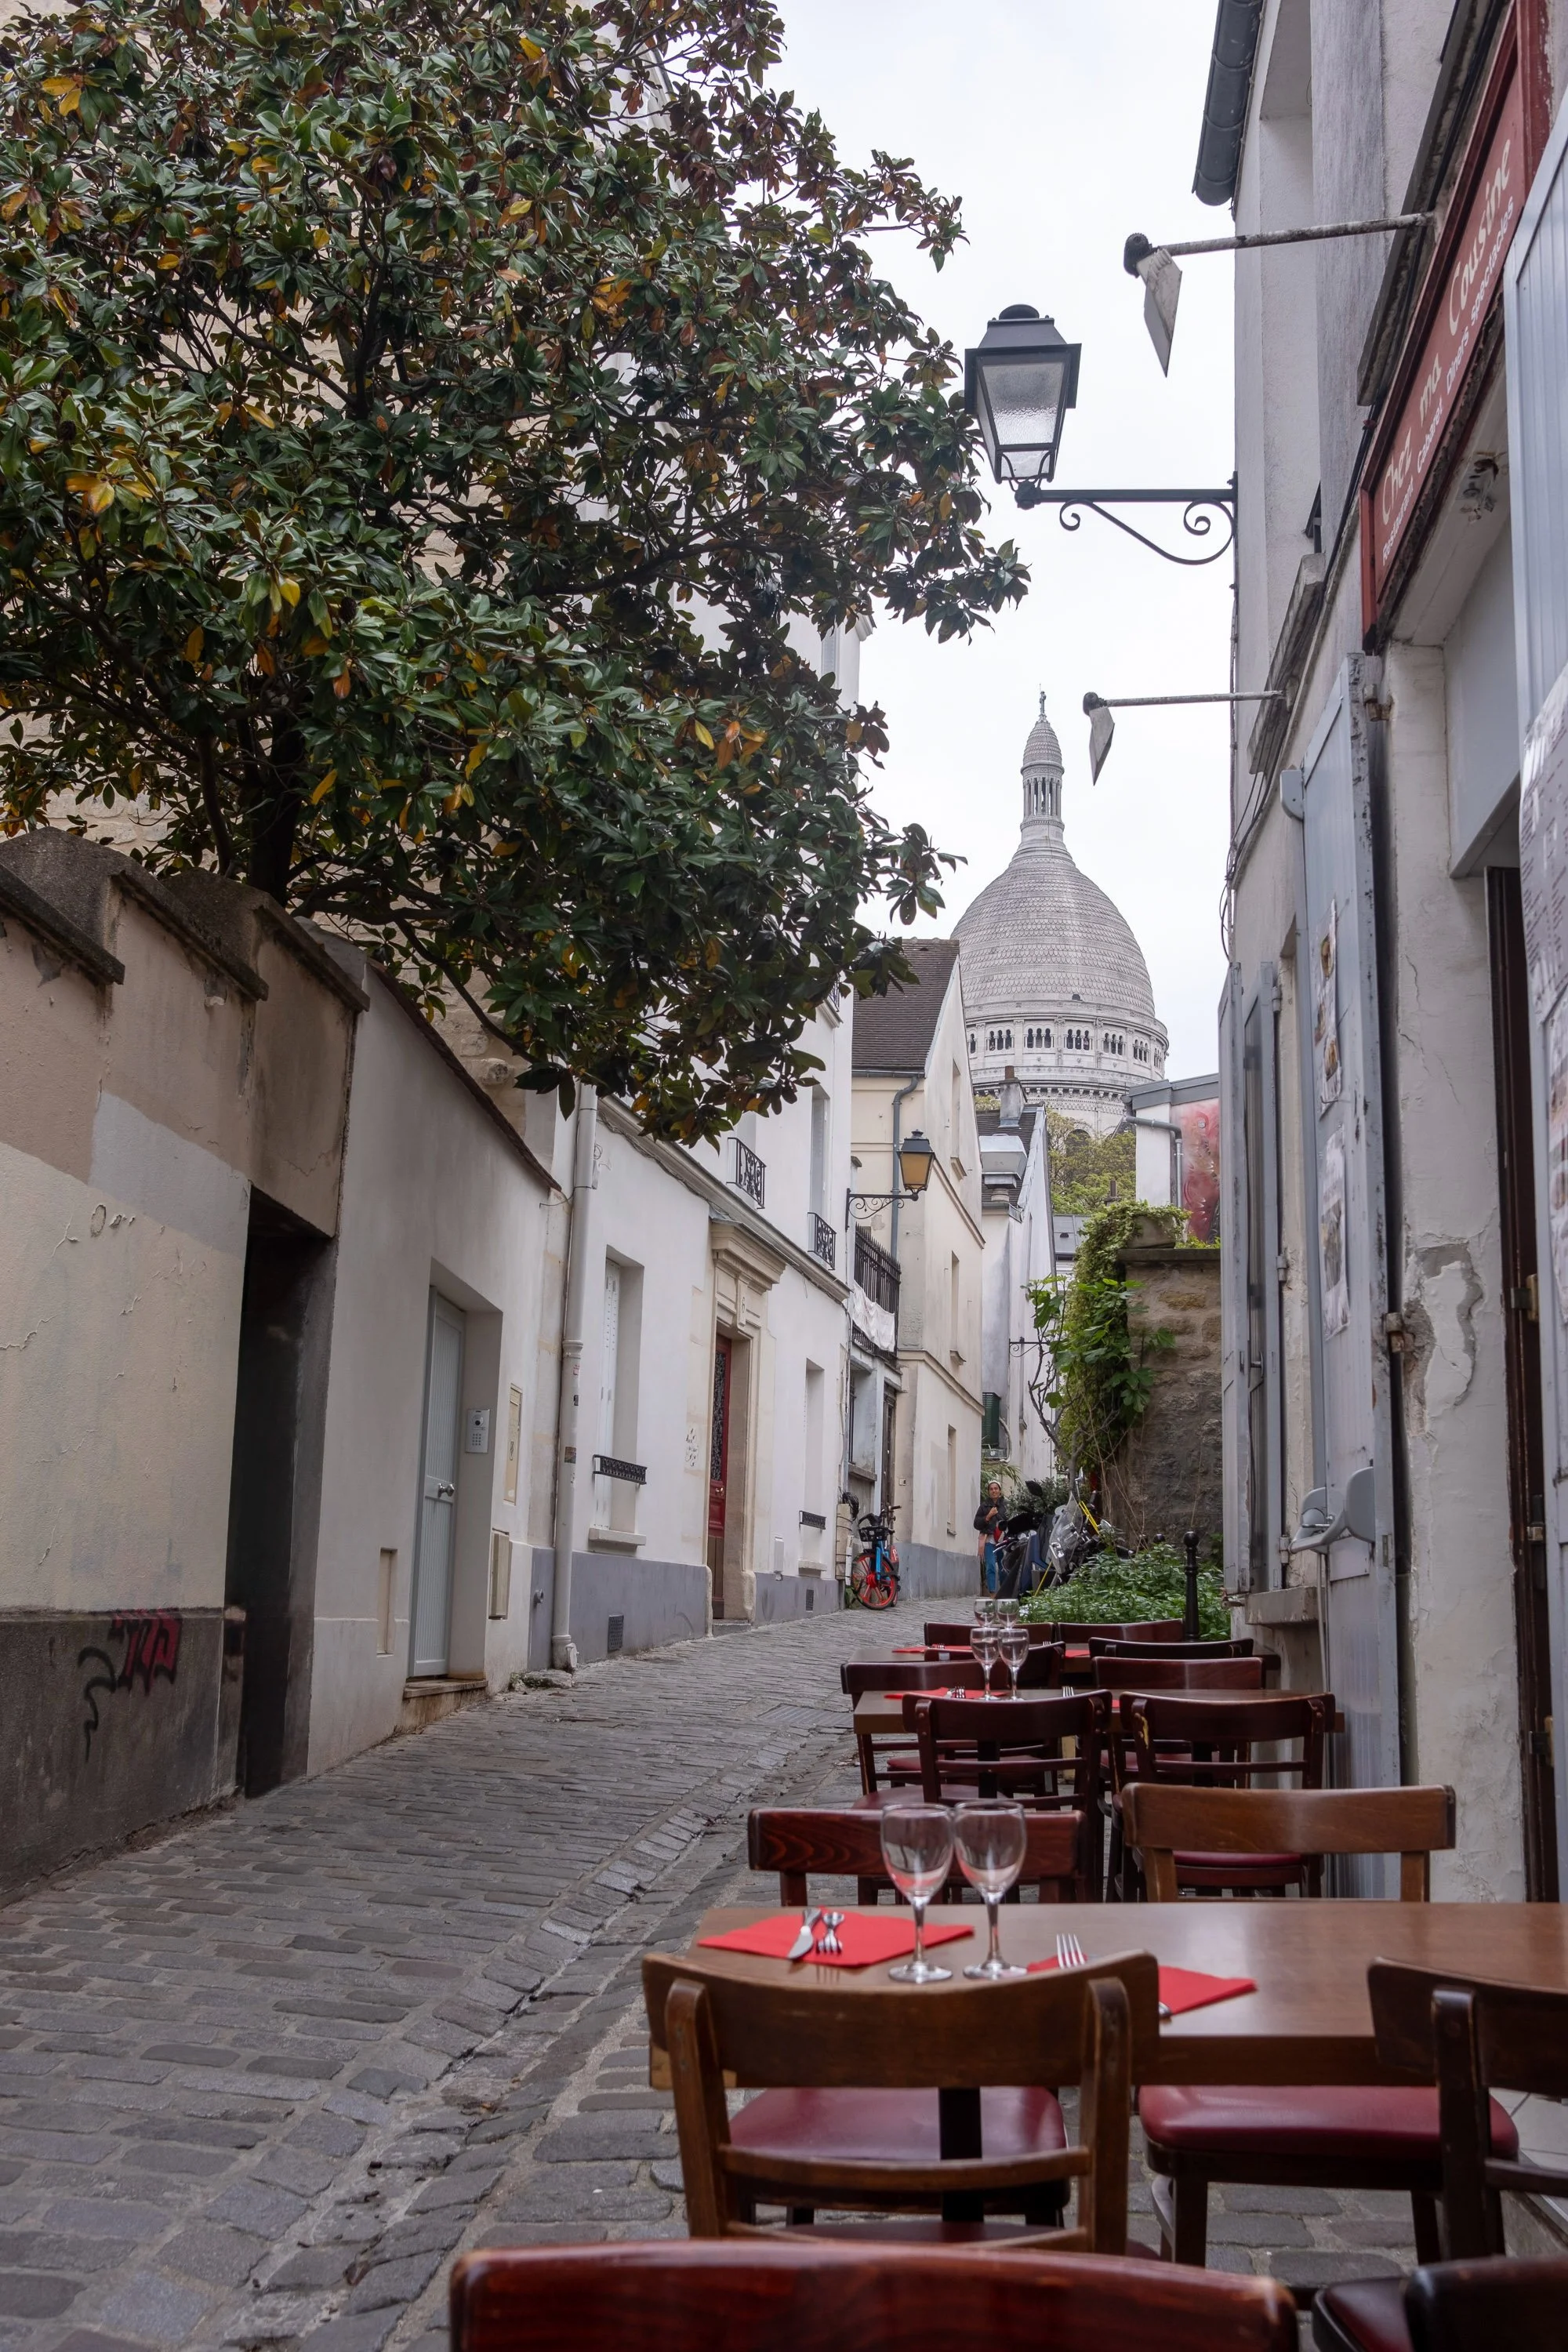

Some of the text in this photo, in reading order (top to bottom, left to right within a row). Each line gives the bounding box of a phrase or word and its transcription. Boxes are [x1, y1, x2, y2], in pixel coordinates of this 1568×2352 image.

[1382, 139, 1511, 526] Chez ma Cousine
[1382, 476, 1414, 567] Restaurant
[1417, 395, 1443, 474] Cabaret
[1471, 196, 1514, 327] spectacles
